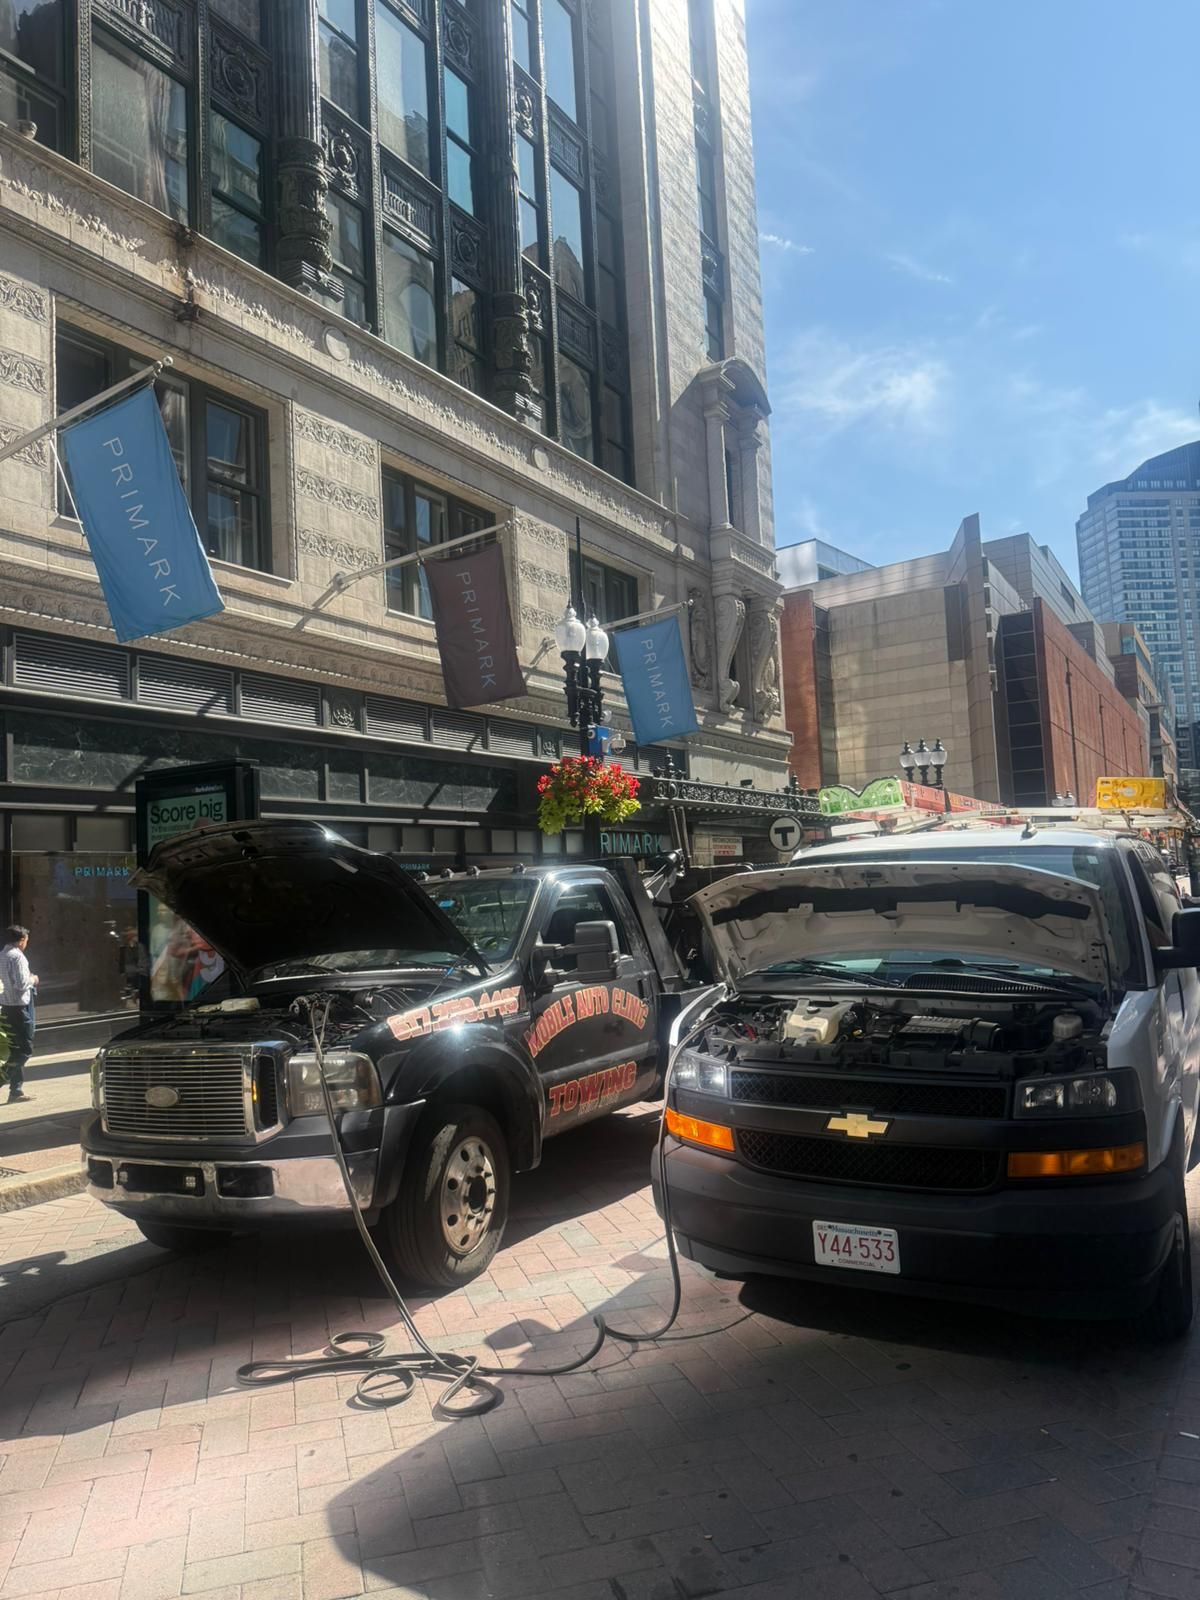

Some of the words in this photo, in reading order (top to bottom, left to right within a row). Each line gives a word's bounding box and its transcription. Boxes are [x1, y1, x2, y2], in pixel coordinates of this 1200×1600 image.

[103, 437, 181, 606] PRIMARK
[456, 571, 496, 688] PRIMARK
[641, 639, 673, 728] PRIMARK
[150, 805, 196, 824] Score
[198, 798, 224, 822] big
[774, 826, 795, 846] T
[600, 832, 662, 854] RIMARK
[74, 866, 129, 877] PRIMARK
[523, 994, 576, 1058] MOBILE
[575, 985, 609, 1020] AUTO
[611, 987, 649, 1030] CLINIC
[549, 1061, 637, 1117] TOWING
